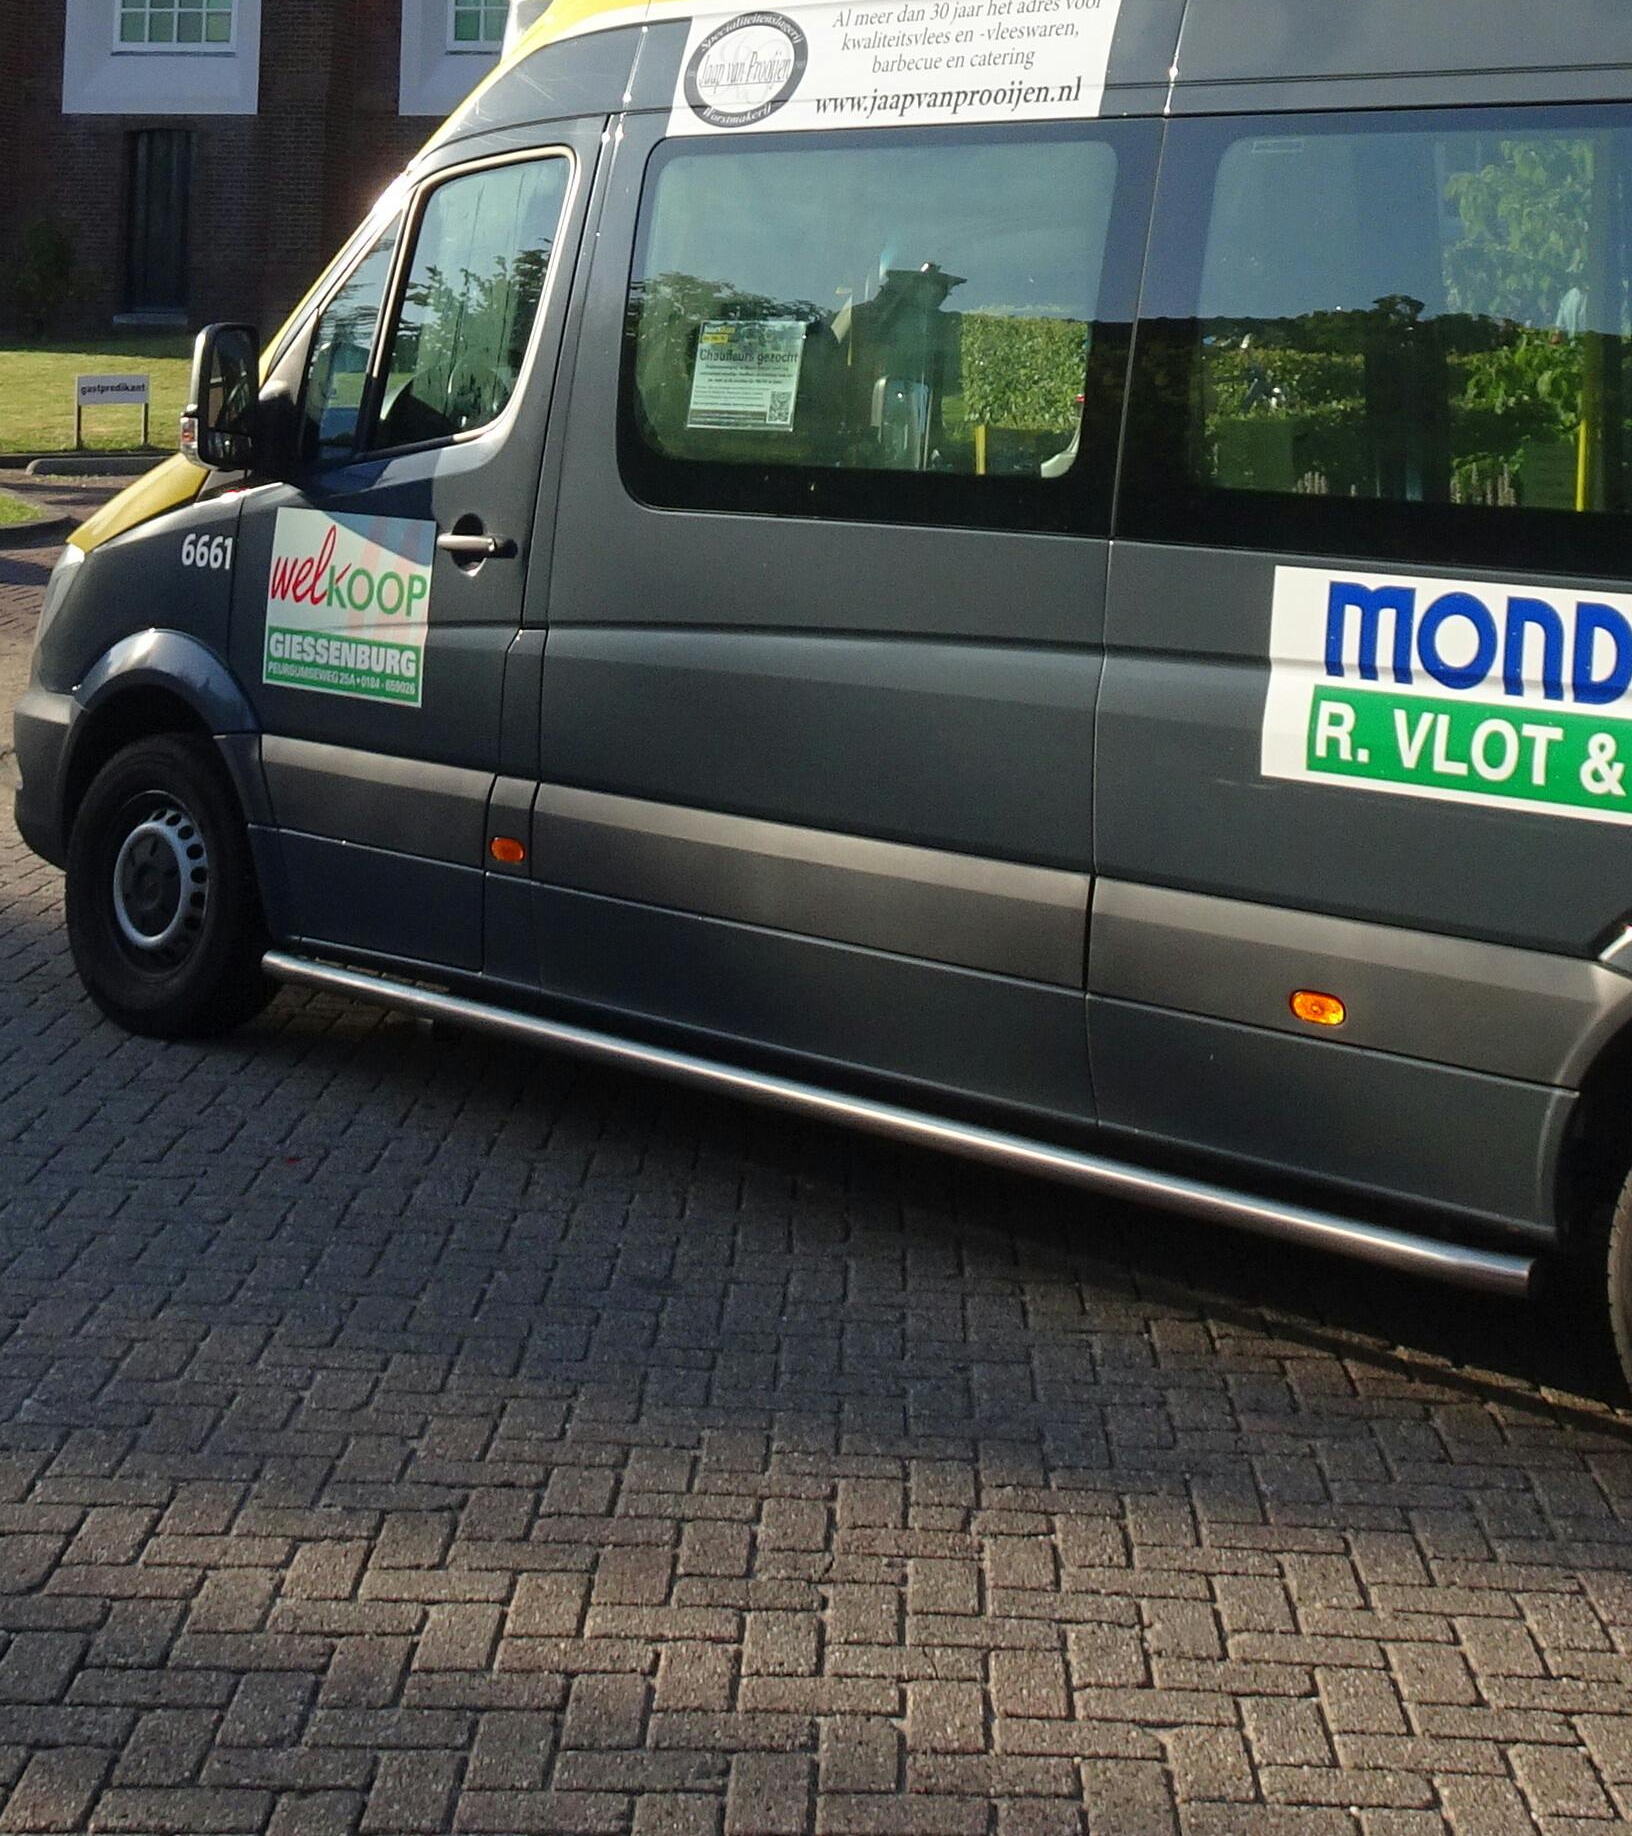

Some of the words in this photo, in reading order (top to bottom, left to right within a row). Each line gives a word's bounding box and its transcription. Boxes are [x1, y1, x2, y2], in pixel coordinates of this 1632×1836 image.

[832, 9, 851, 28] Al
[855, 9, 894, 27] meer
[896, 5, 925, 23] dan
[929, 3, 949, 21] 30
[950, 1, 984, 25] jaar
[841, 27, 951, 51] kwaliteitsvlees
[955, 28, 974, 43] en
[979, 22, 1080, 41] -vleeswaren,
[699, 53, 726, 94] Jaap
[727, 60, 746, 83] van
[745, 51, 792, 90] Prooijen
[871, 55, 942, 73] barbecue
[946, 55, 965, 69] en
[969, 48, 1036, 70] catering
[815, 76, 1083, 119] www.jaapvanprooijen.nl
[181, 533, 233, 570] 6661
[270, 635, 416, 677] GIESSENBURG
[1313, 698, 1370, 765] R.
[1395, 708, 1564, 790] VLOT
[1580, 737, 1626, 797] &
